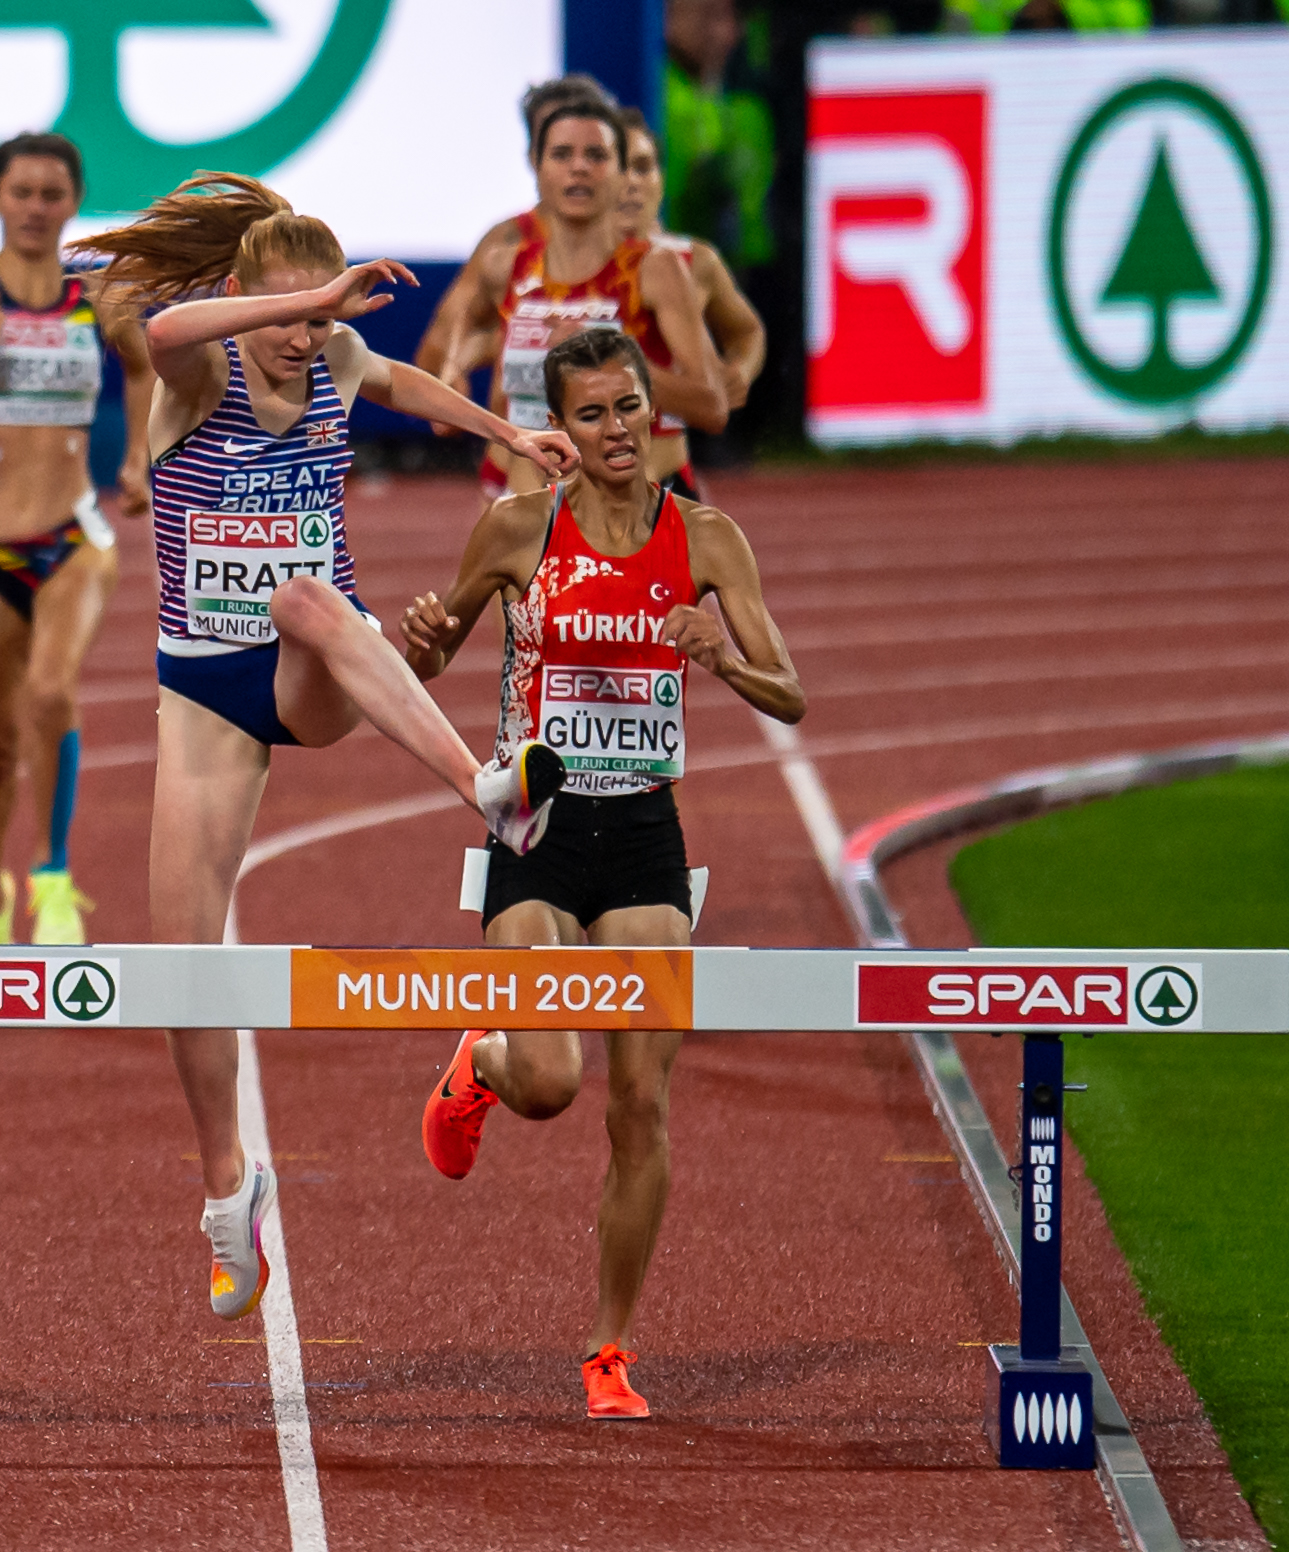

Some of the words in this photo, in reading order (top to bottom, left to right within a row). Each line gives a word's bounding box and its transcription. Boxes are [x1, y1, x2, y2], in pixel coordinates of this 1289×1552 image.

[223, 463, 332, 493] GREAT
[219, 488, 329, 514] BRITAIN
[192, 518, 295, 544] SPAR
[227, 602, 255, 614] RUN
[196, 615, 271, 638] MUNICH
[553, 609, 667, 644] TÜRKİY
[549, 674, 648, 700] SPAR
[544, 711, 679, 761] GÜVENÇ
[581, 758, 609, 769] RUN
[612, 760, 651, 771] CLEAN
[565, 773, 626, 791] UNICH
[338, 973, 517, 1011] MUNICH
[535, 974, 645, 1011] 2022
[928, 974, 1122, 1016] SPAR
[1030, 1145, 1055, 1242] MONDO
